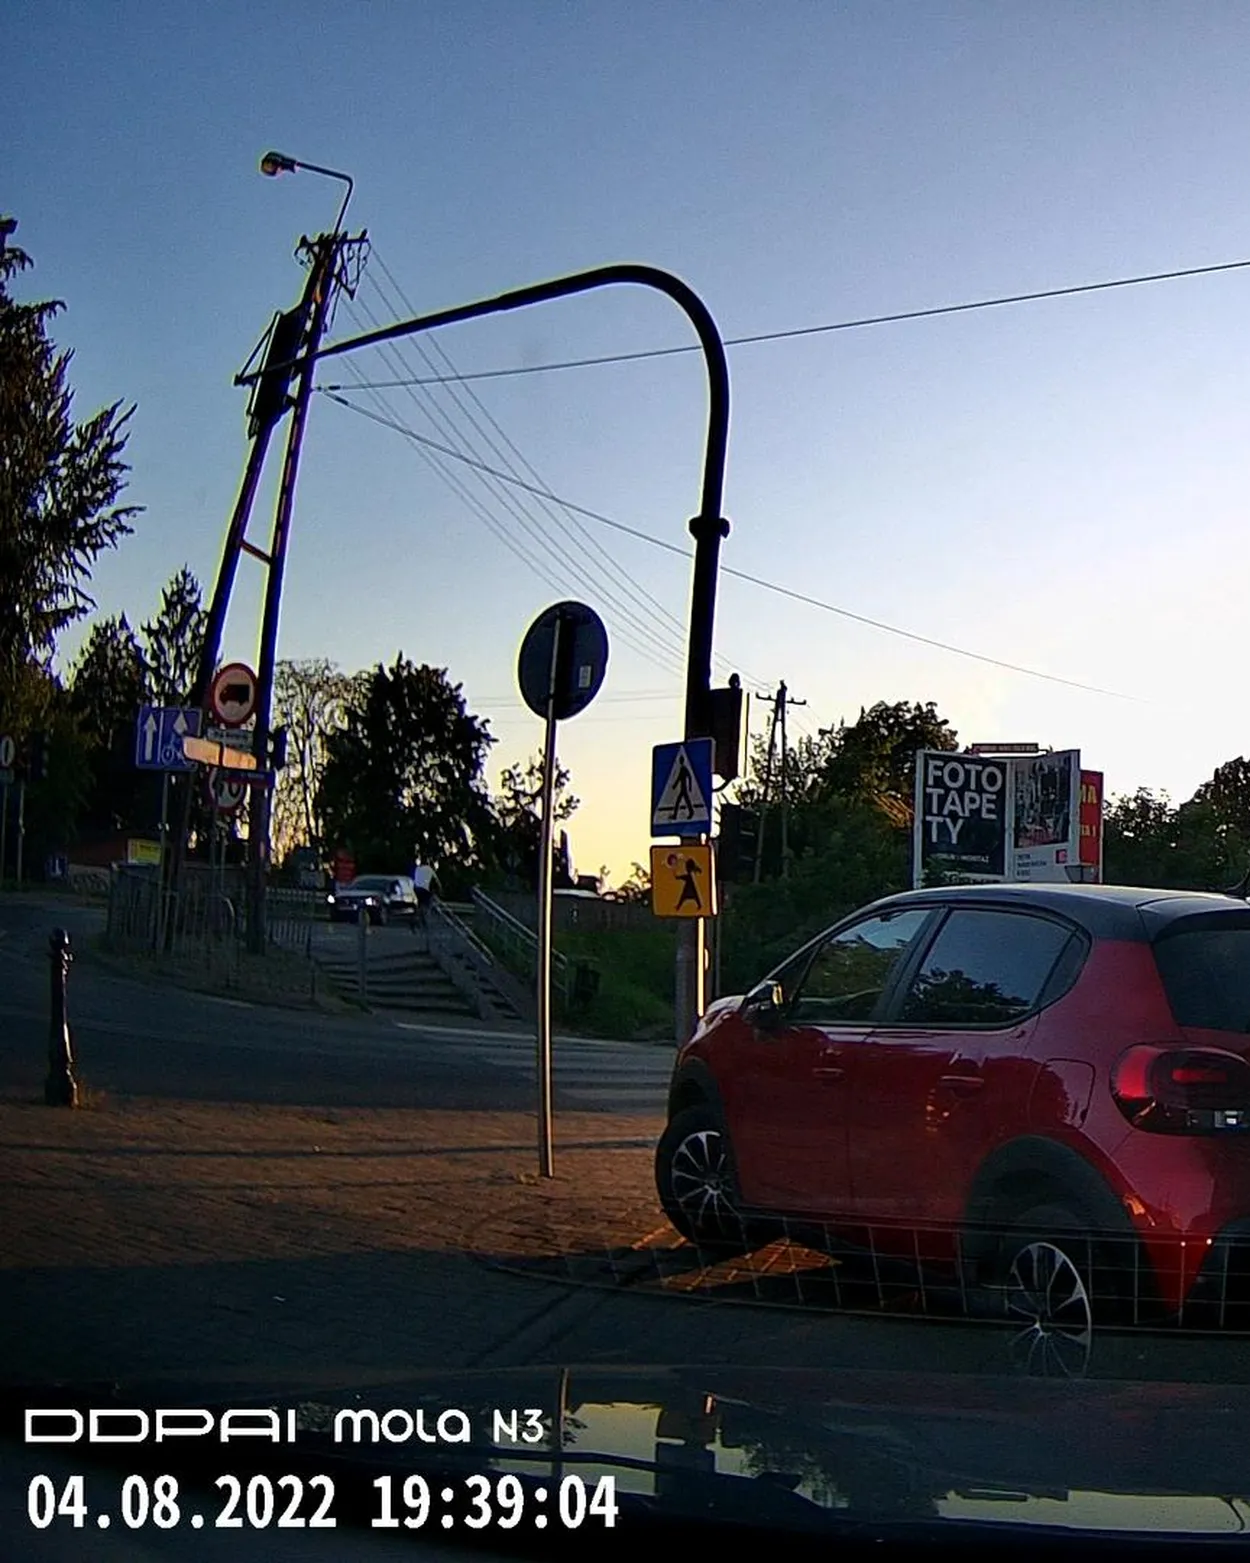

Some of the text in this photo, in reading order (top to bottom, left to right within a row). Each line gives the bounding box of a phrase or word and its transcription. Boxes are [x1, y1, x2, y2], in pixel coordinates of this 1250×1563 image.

[927, 760, 1003, 793] FOTO
[925, 787, 997, 820] TAPE
[925, 815, 965, 844] TY
